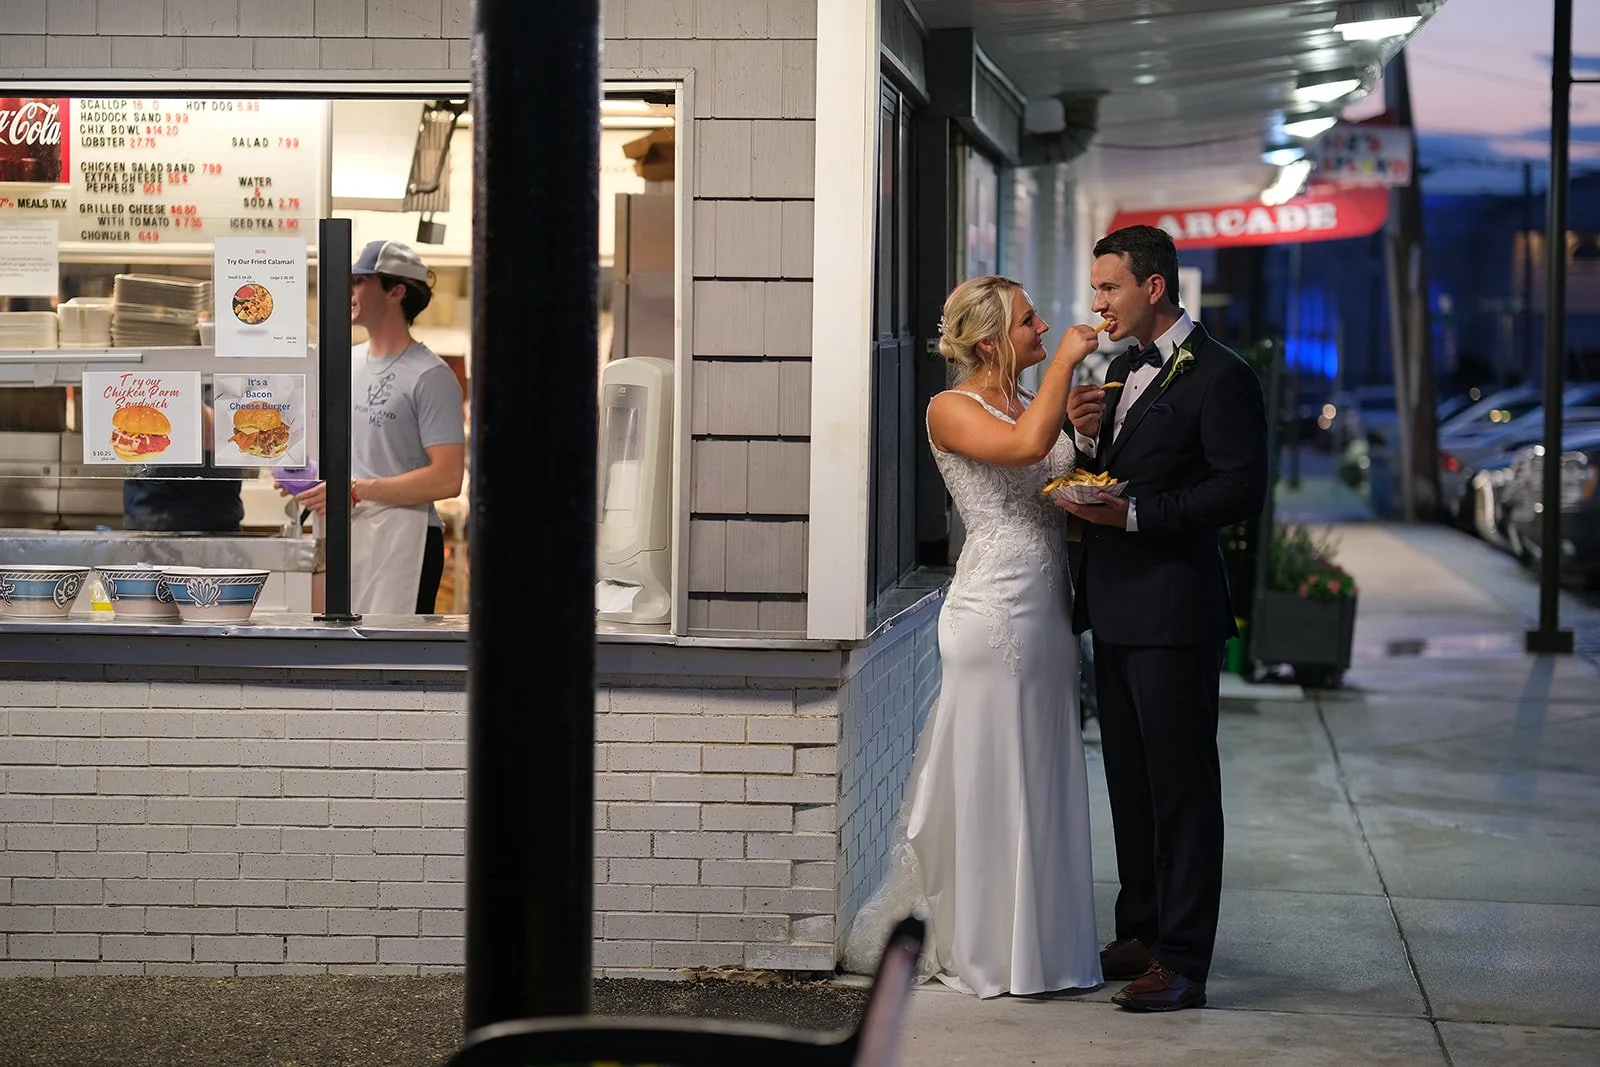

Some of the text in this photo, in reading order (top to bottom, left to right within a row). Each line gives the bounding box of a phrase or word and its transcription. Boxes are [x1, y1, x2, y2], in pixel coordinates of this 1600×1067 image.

[80, 99, 127, 110] SCALLOP
[186, 101, 206, 112] HOT
[212, 101, 233, 112] DOG
[80, 112, 127, 122] HADDOCK
[133, 112, 161, 123] SAND
[80, 124, 104, 135] CHIX
[111, 125, 140, 136] BOWL
[81, 137, 125, 148] LOBSTER
[231, 137, 269, 148] SALAD
[80, 162, 126, 173] CHICKEN
[131, 163, 163, 174] SALAD
[166, 163, 195, 174] SAND
[84, 172, 117, 182] EXTRA
[122, 172, 163, 183] CHEESE
[238, 176, 272, 188] WATER
[86, 183, 135, 193] PEPPERS
[17, 198, 48, 208] MEALS
[51, 199, 67, 209] TAX
[243, 197, 273, 208] SODA
[79, 204, 124, 215] GRILLED
[128, 204, 166, 215] CHEESE
[97, 217, 125, 228] WITH
[129, 217, 170, 228] TOMATO
[230, 218, 254, 229] ICED
[255, 218, 274, 229] TEA
[1157, 202, 1337, 240] ARCADE
[80, 230, 131, 241] CHOWDER
[145, 378, 163, 386] our
[247, 378, 261, 386] It's
[103, 385, 182, 399] Chicken Parm
[245, 390, 272, 398] Bacon
[114, 397, 170, 410] Sandwich
[229, 402, 291, 411] Cheese Burger
